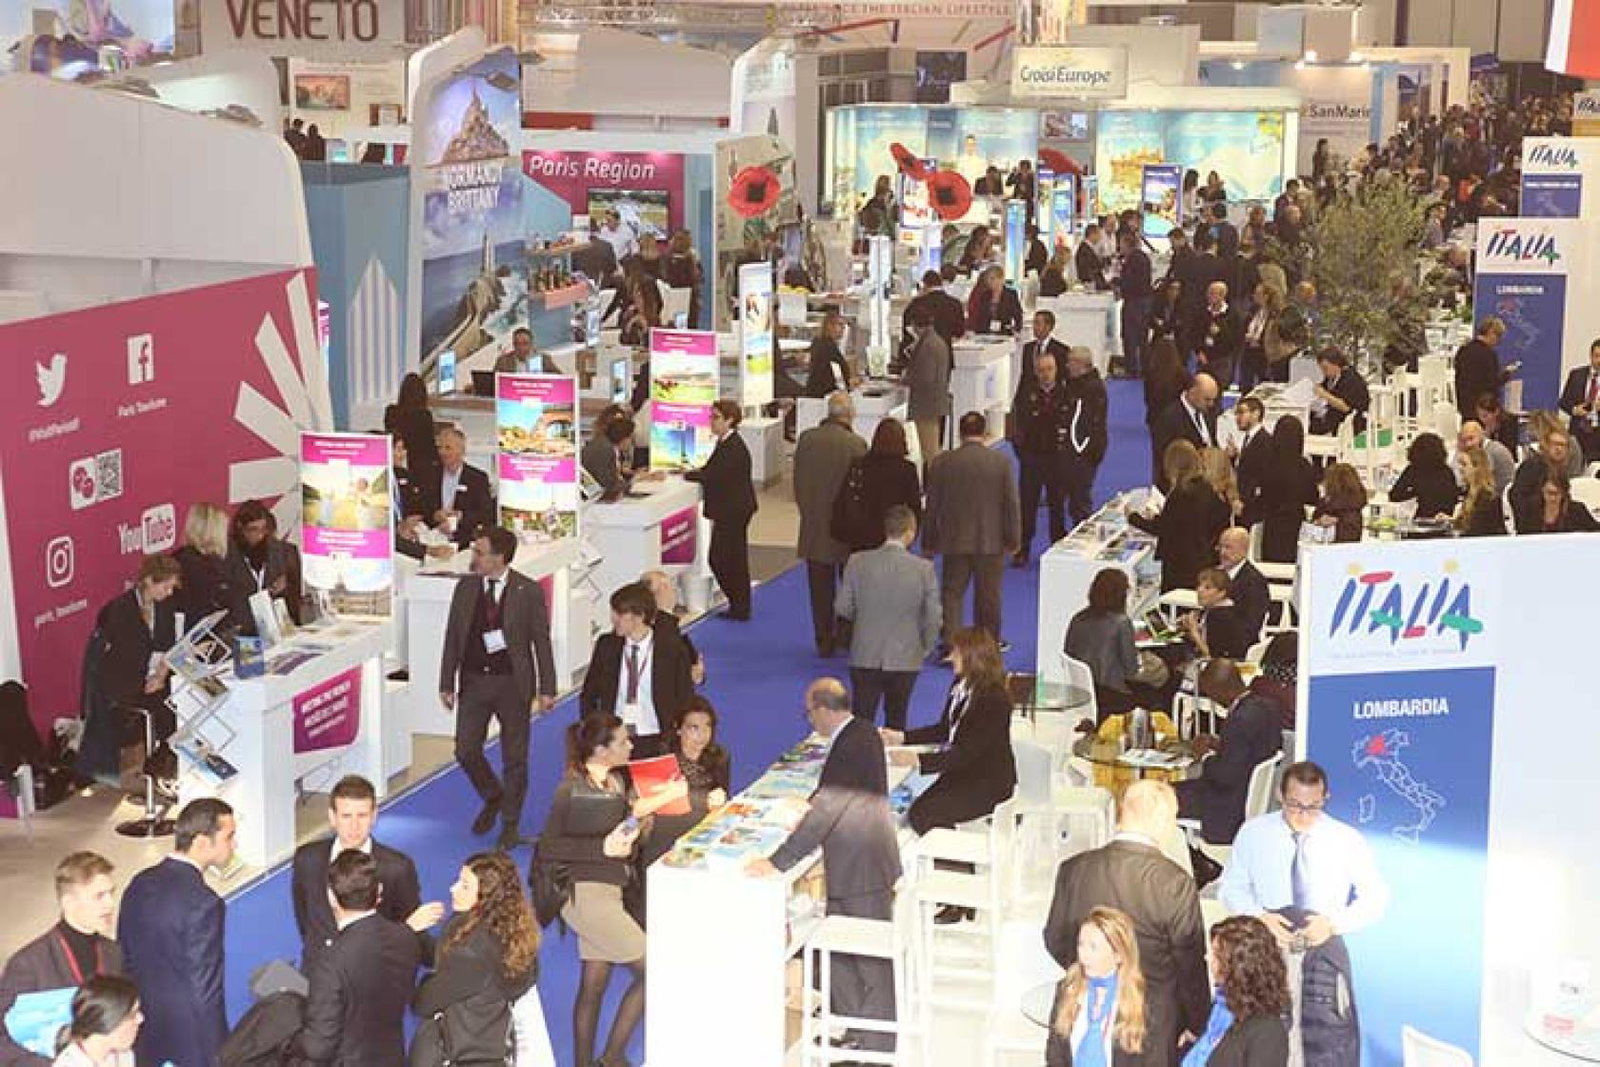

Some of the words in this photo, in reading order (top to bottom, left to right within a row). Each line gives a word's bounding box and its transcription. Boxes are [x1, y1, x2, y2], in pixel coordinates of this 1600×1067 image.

[226, 0, 379, 41] VENETO
[1020, 65, 1112, 87] CroisiEurope
[529, 155, 578, 177] Paris
[584, 157, 657, 183] Region
[1528, 144, 1579, 168] ITALIA
[1485, 227, 1561, 266] ITALIA
[118, 506, 175, 555] YouTube
[1330, 560, 1484, 652] ITALIA
[1352, 697, 1449, 720] LOMBARDIA
